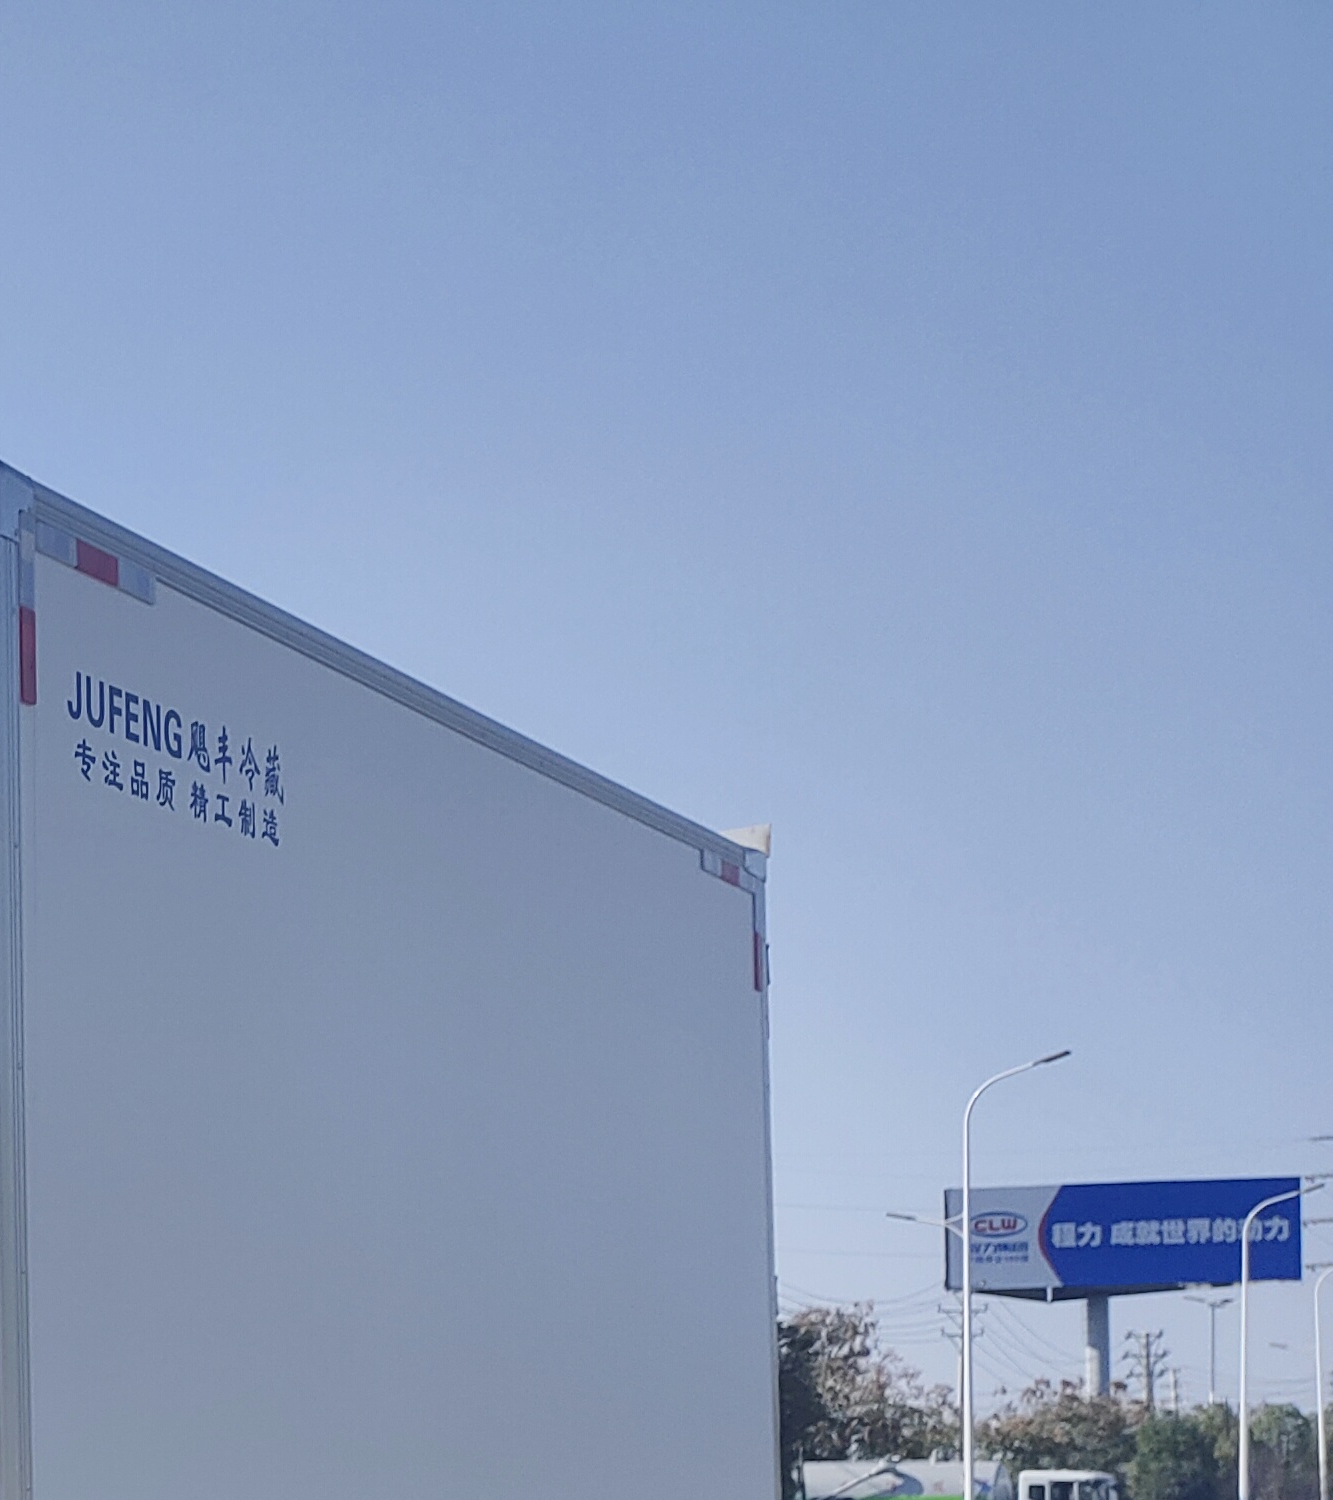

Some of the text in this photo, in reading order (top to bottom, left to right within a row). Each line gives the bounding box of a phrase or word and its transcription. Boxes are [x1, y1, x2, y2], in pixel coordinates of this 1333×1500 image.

[67, 671, 183, 760] JUFENG
[74, 738, 281, 848] 专注品质 精工制造
[974, 1217, 1018, 1233] CLW
